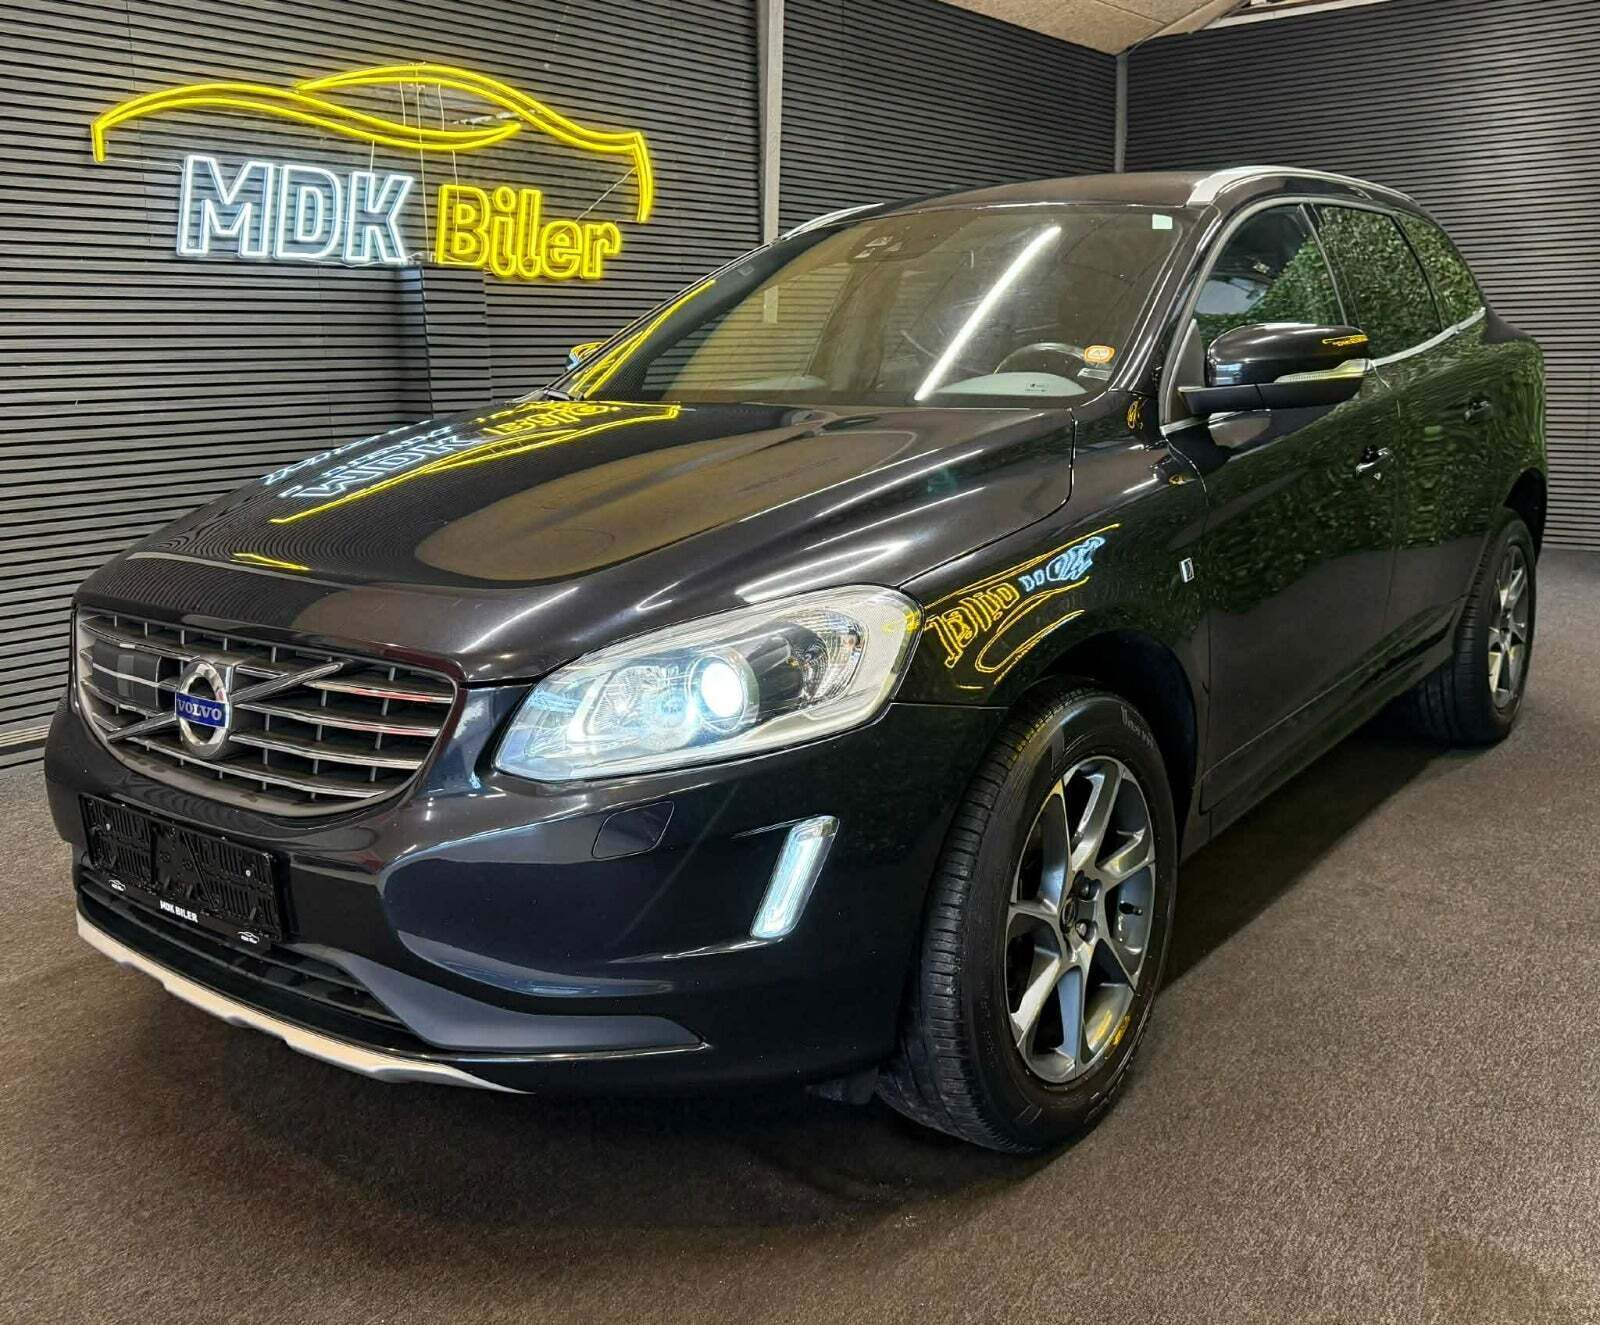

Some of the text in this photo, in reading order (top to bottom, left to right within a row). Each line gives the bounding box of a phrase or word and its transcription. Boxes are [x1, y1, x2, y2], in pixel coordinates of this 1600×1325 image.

[176, 154, 622, 280] MDK Biler
[176, 698, 222, 721] VOLVO
[175, 905, 199, 923] BILER
